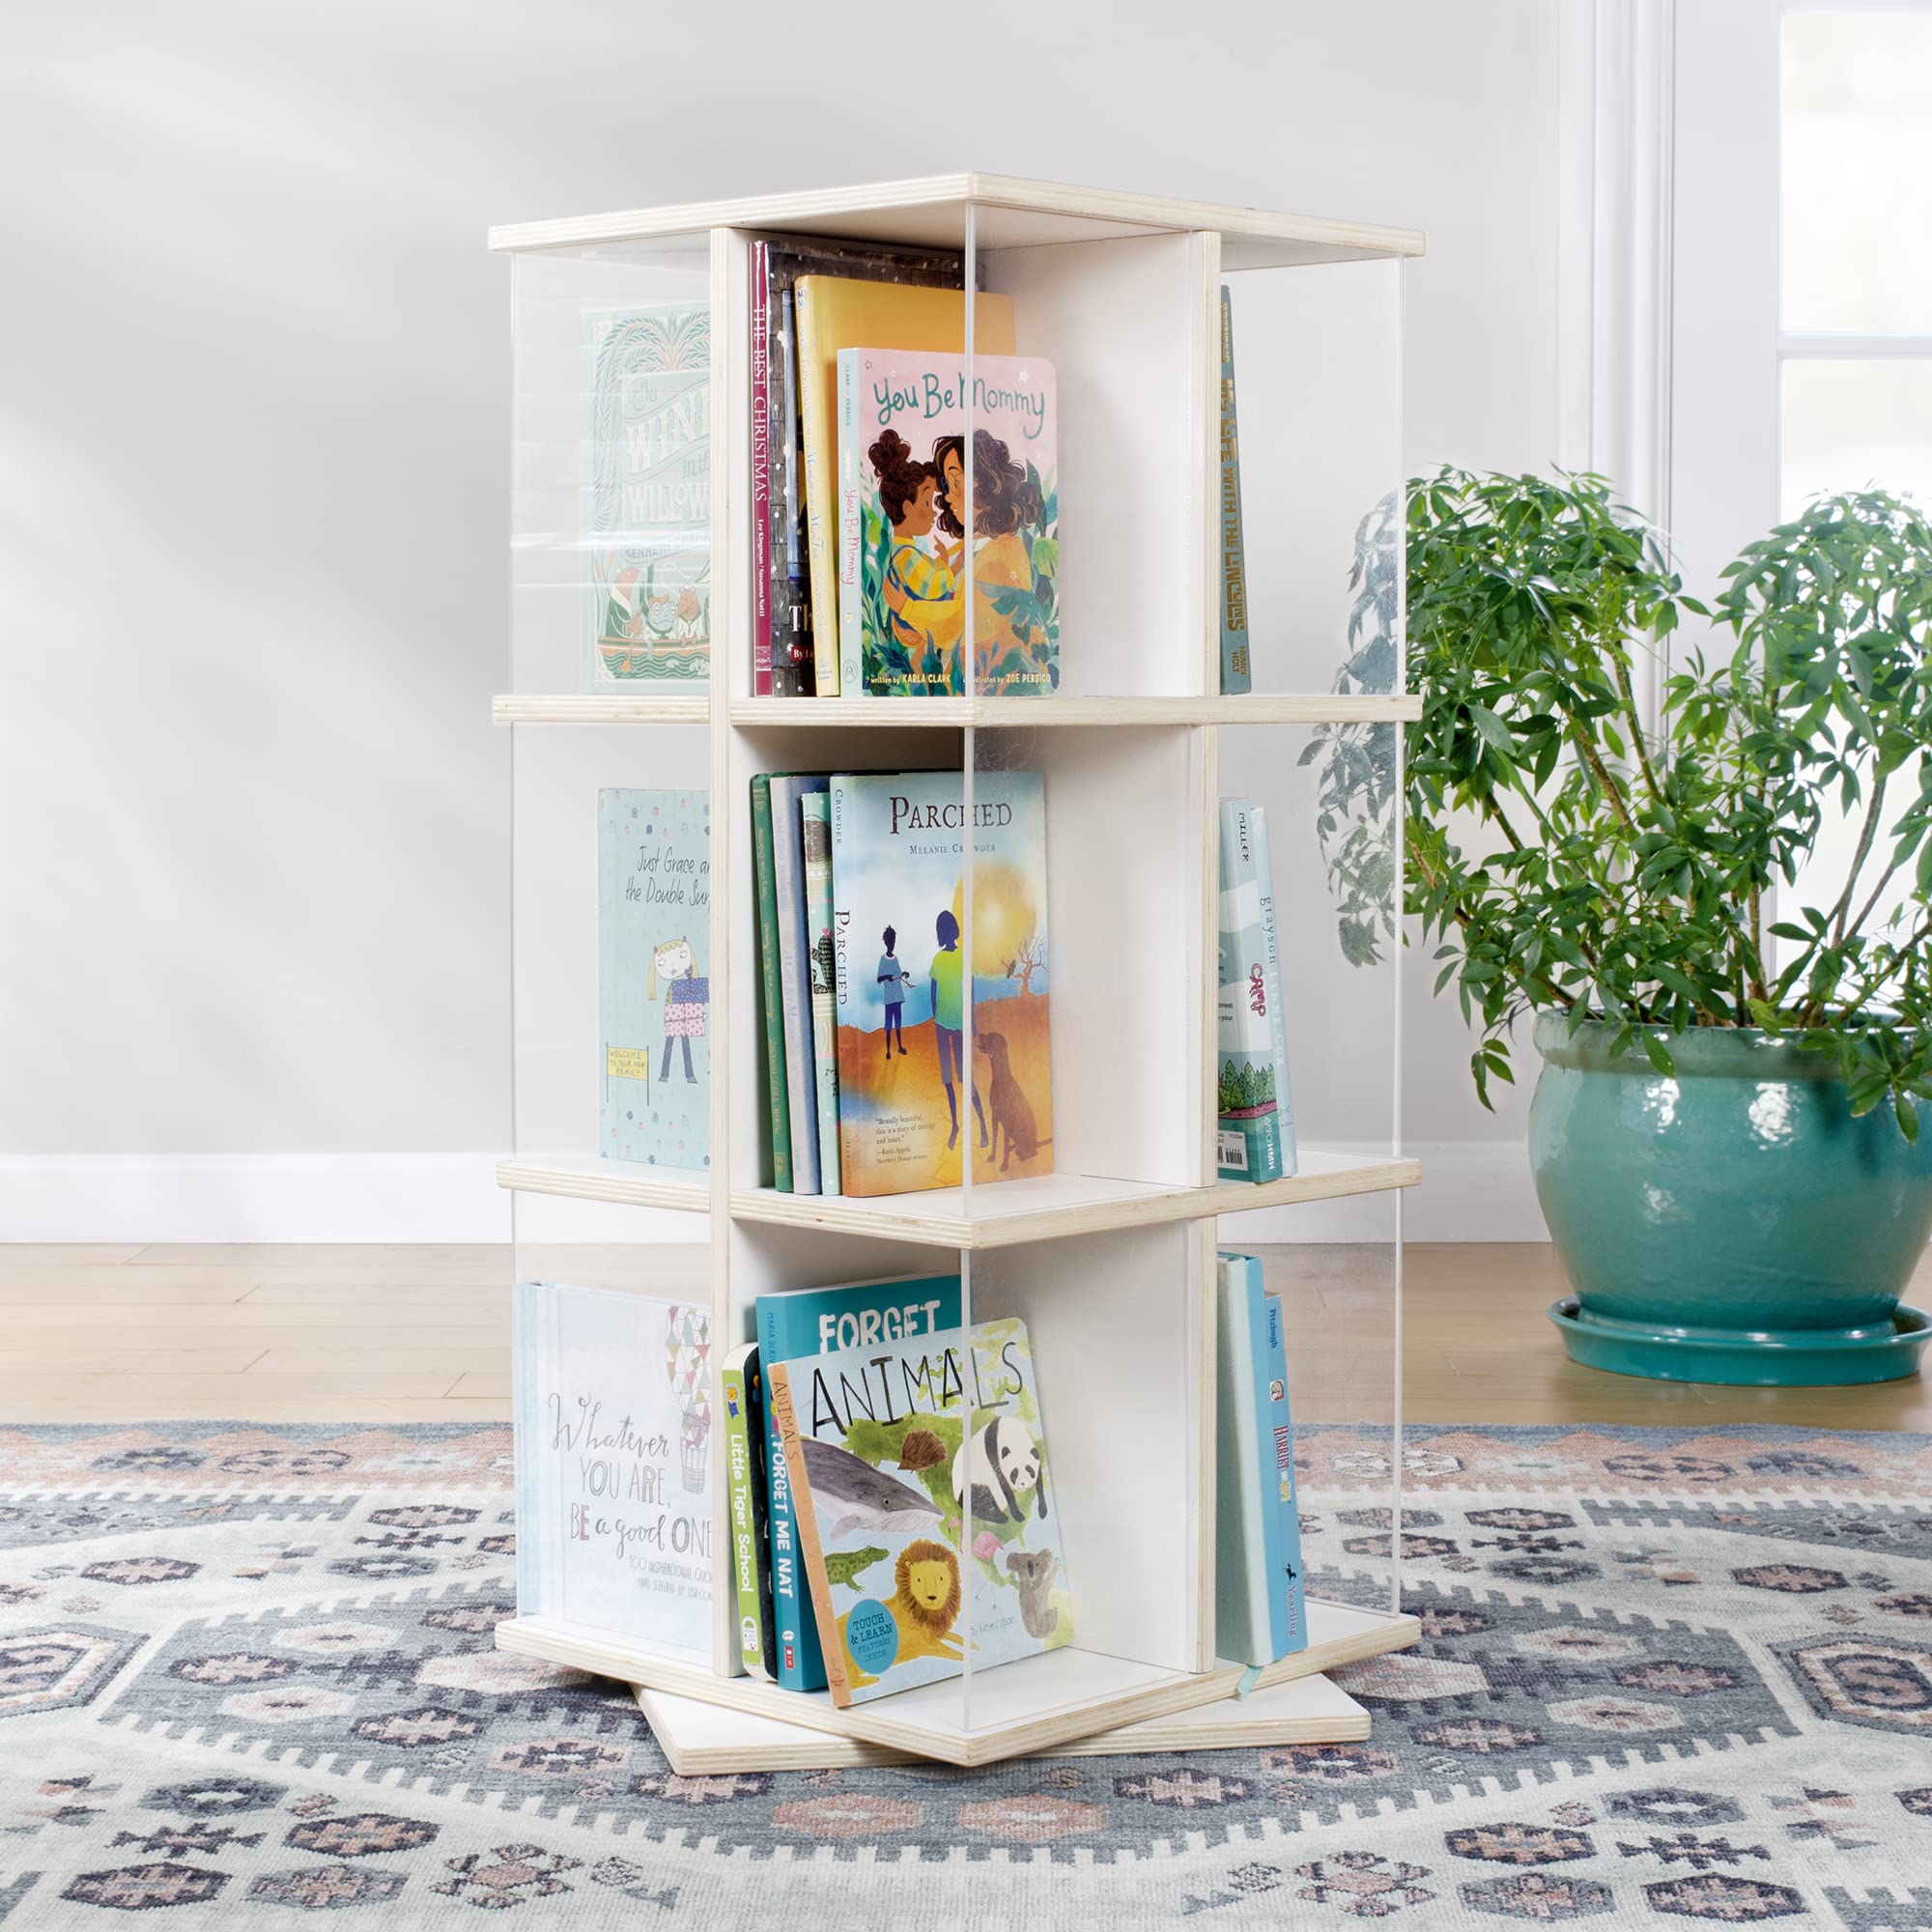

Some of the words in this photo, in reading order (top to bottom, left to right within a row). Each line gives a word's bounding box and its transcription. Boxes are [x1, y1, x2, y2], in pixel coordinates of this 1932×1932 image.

[753, 303, 767, 340] THE
[753, 349, 767, 388] BEST
[874, 378, 919, 425] You
[923, 373, 955, 418] Be
[958, 372, 1045, 440] Mommy
[754, 396, 767, 501] CHRISTMAS
[843, 490, 859, 513] You
[844, 518, 860, 534] Be
[841, 537, 861, 586] Mommy
[788, 603, 813, 632] Th
[894, 676, 900, 685] by
[902, 672, 925, 684] KARLA
[927, 672, 952, 684] CLARK
[1232, 651, 1240, 672] HOLT
[835, 789, 843, 845] CROWDER
[889, 796, 1012, 835] PARCHED
[909, 844, 948, 855] MELANIE
[952, 843, 996, 853] CRWDER
[1237, 812, 1249, 862] MILLER
[638, 845, 660, 872] Just
[665, 846, 695, 874] Grace
[626, 876, 641, 902] the
[646, 876, 684, 904] Double
[1260, 896, 1276, 963] grayson
[836, 910, 850, 1006] PARCHED
[1249, 962, 1266, 1017] CAMP
[610, 1050, 641, 1060] WELCOME
[616, 1067, 639, 1076] FAMILY
[766, 1312, 775, 1338] MARIA
[819, 1299, 941, 1353] FORGET
[1268, 1308, 1278, 1350] Fitzhugh
[768, 1340, 777, 1363] SCRIV
[812, 1341, 1023, 1437] ANIMALS
[548, 1392, 670, 1459] Whatever
[773, 1381, 799, 1461] ANIMALS
[731, 1434, 746, 1480] Little
[1273, 1425, 1290, 1468] HARRIET
[580, 1456, 620, 1499] YOU
[629, 1462, 671, 1508] ARE,
[772, 1440, 788, 1513] FORGET
[733, 1485, 747, 1528] Tiger
[571, 1502, 589, 1541] BE
[595, 1518, 611, 1535] a
[615, 1515, 667, 1559] good
[671, 1518, 712, 1558] ONE
[775, 1520, 791, 1550] ME
[629, 1554, 647, 1571] 100
[694, 1567, 712, 1584] QUO
[737, 1533, 753, 1593] School
[778, 1557, 793, 1598] NAT
[853, 1612, 885, 1631] TOUCH
[1289, 1585, 1298, 1636] Yearling
[851, 1634, 859, 1645] &
[860, 1623, 893, 1641] LEARN
